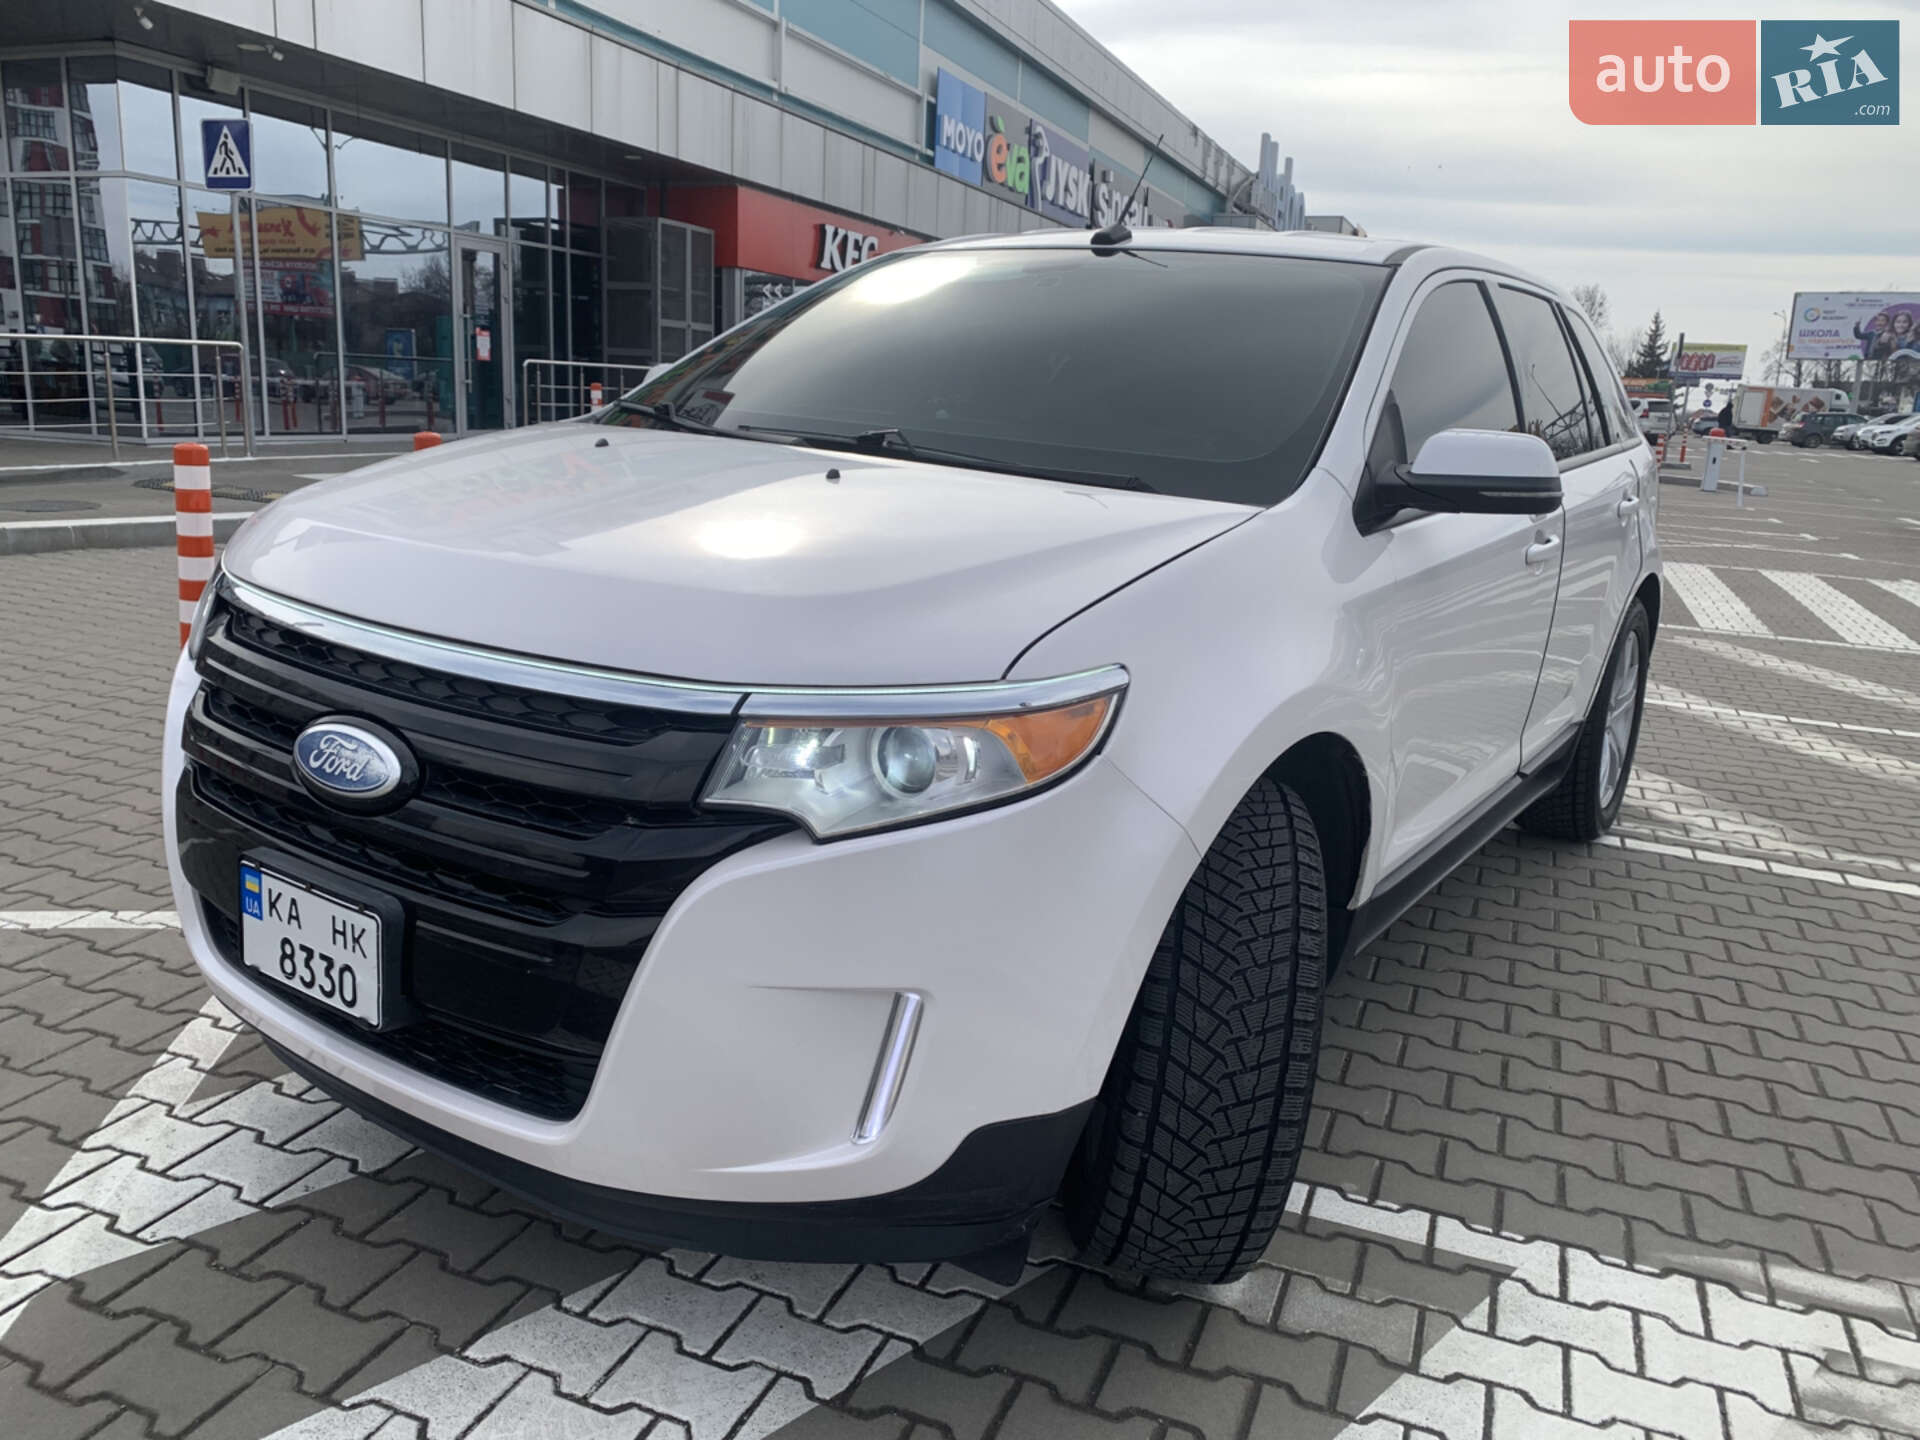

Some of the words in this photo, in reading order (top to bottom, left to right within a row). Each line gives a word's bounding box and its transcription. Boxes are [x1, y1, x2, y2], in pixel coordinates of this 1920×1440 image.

[943, 114, 985, 163] MOYO
[1046, 155, 1091, 218] JYSK
[1798, 329, 1841, 338] ШКОЛА
[309, 735, 370, 781] Ford
[245, 897, 261, 919] UA
[268, 888, 302, 930] KA
[331, 915, 368, 959] HK
[279, 937, 357, 1008] 8330
